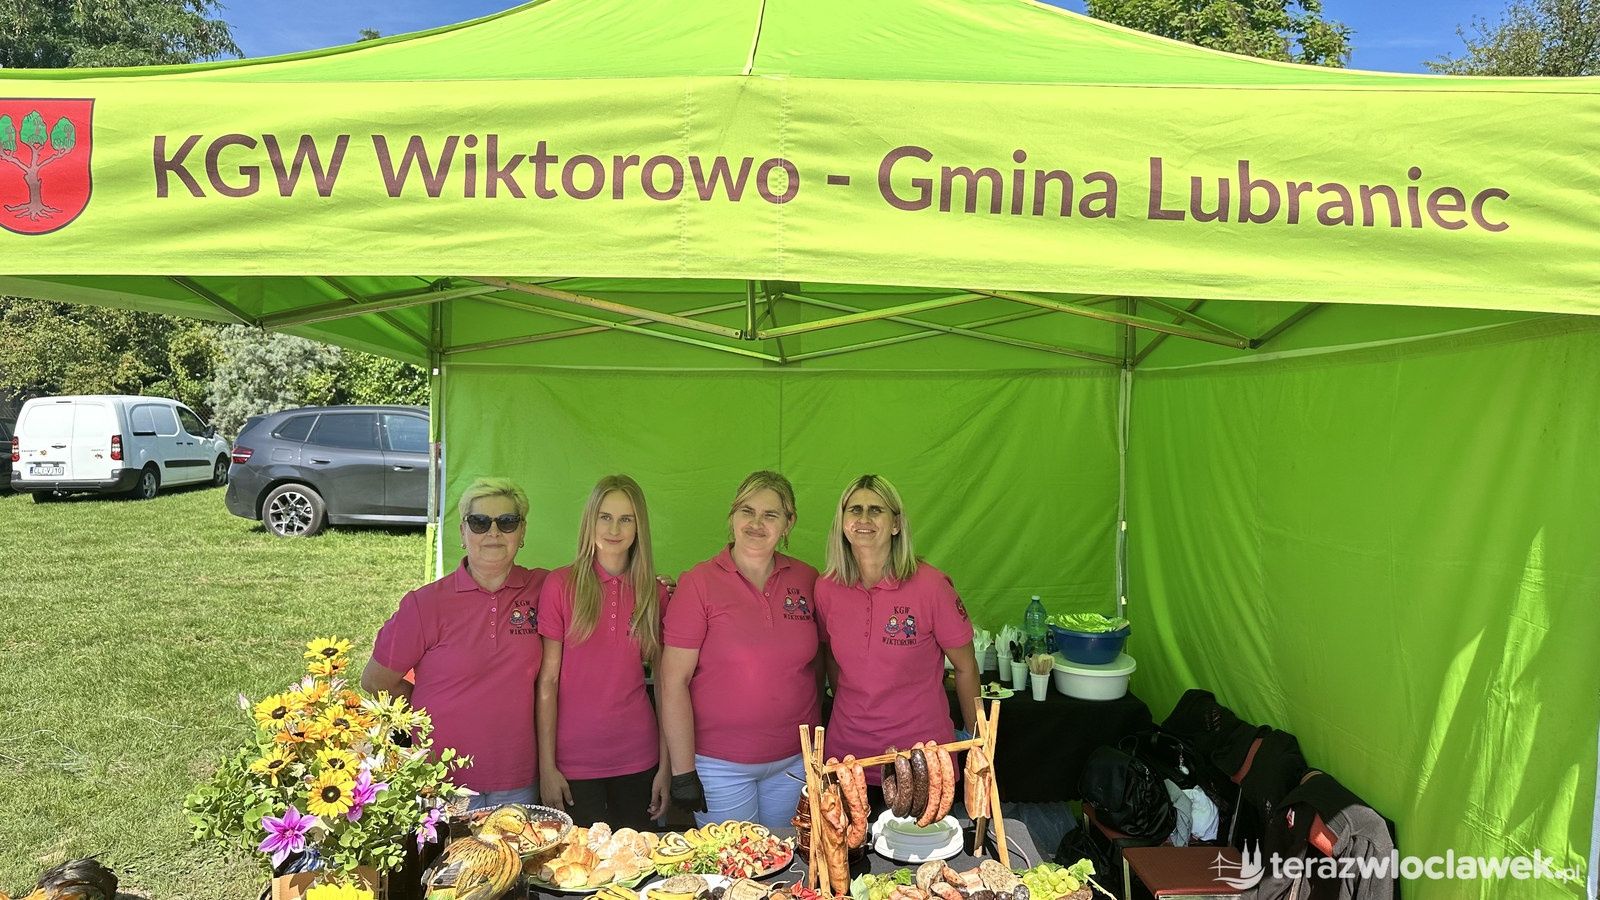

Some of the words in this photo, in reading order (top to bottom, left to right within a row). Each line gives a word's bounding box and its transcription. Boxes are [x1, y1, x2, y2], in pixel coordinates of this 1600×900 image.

[154, 134, 350, 197] KGW
[371, 134, 799, 204] Wiktorowo
[878, 146, 1117, 218] Gmina
[1148, 157, 1509, 232] Lubraniec
[894, 606, 910, 614] KGW
